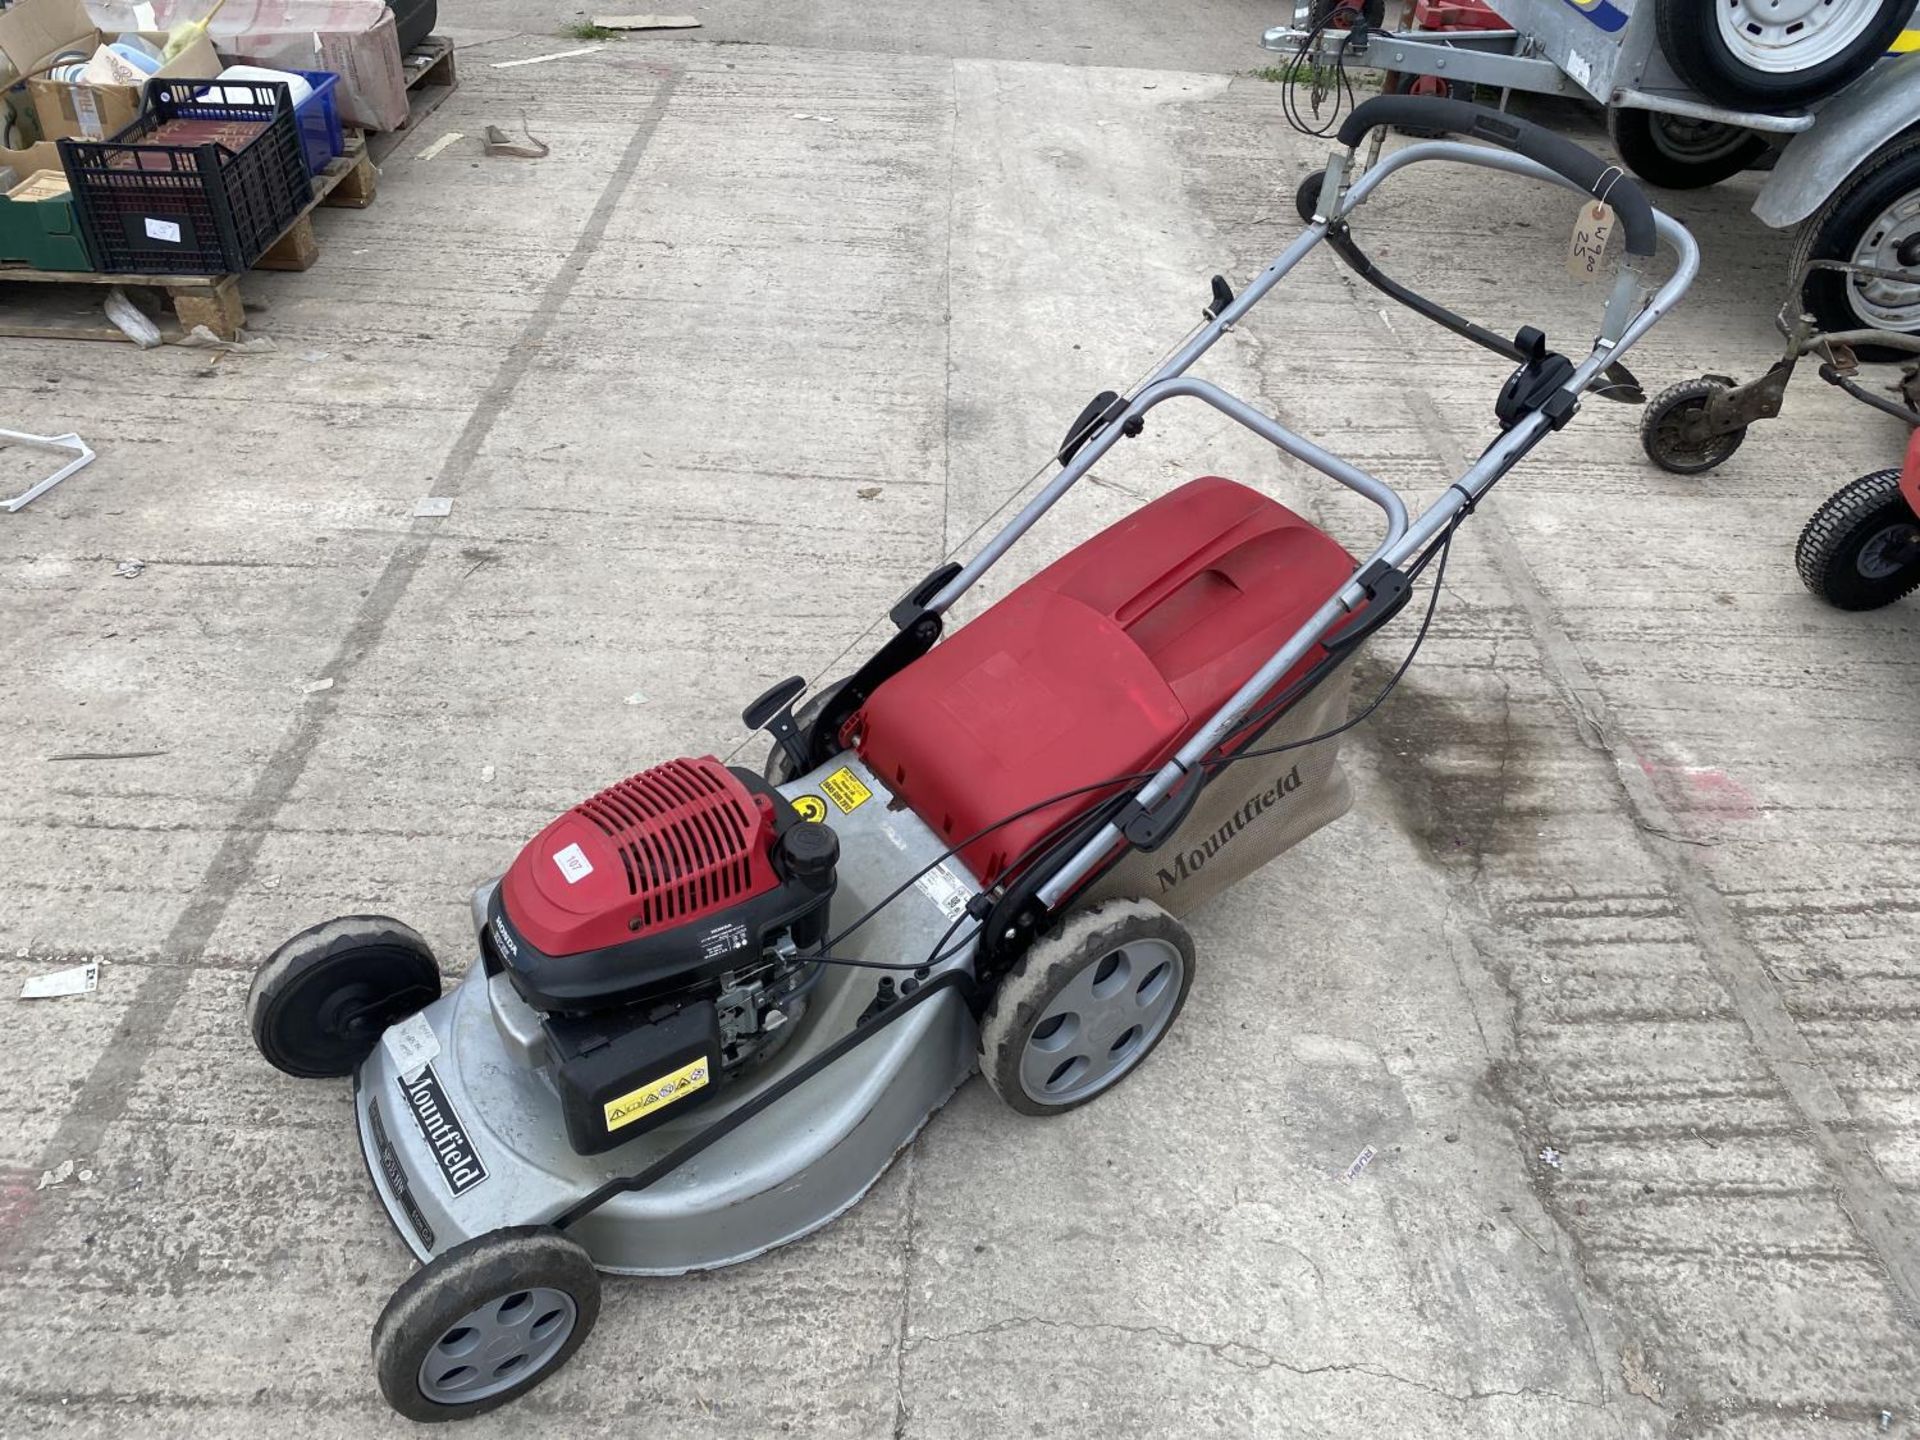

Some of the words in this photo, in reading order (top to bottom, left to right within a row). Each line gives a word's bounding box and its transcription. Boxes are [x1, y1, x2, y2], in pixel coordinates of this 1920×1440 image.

[1573, 230, 1589, 257] 25
[1155, 765, 1303, 894] Mountfield
[567, 855, 583, 870] 107
[496, 915, 518, 957] HONDA
[1347, 1149, 1373, 1179] RUSH
